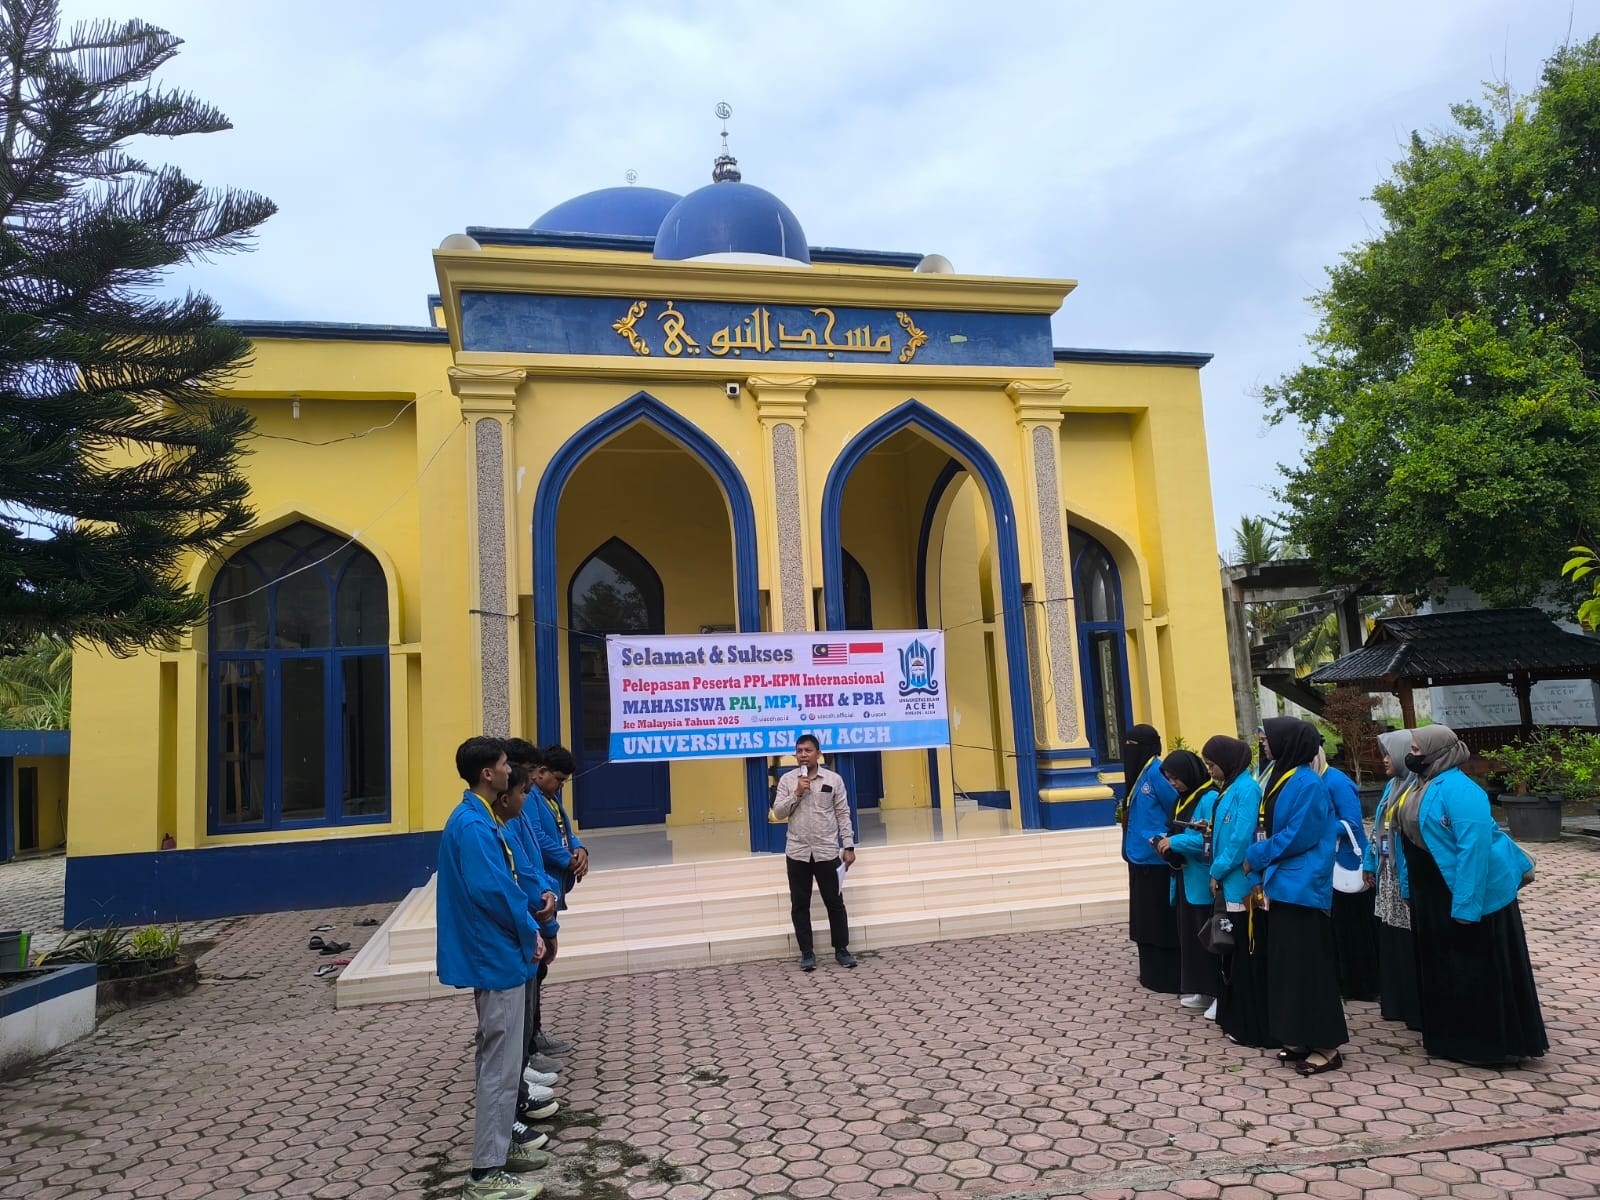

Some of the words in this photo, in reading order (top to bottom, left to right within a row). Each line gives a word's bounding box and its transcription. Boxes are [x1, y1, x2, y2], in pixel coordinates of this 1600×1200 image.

[656, 301, 776, 357] النبوي
[778, 307, 892, 359] مسجد
[622, 646, 706, 667] Selamat
[709, 645, 724, 665] &
[728, 645, 794, 664] Sukses
[622, 678, 691, 696] Pelepasan
[692, 676, 742, 691] Peserta
[744, 673, 801, 689] PPL-KPM
[803, 672, 885, 687] Internasional
[623, 697, 726, 715] MAHASISWA
[729, 696, 762, 713] PAI,
[764, 694, 803, 711] MPI,
[804, 693, 834, 708] HKI
[838, 692, 850, 706] &
[852, 691, 885, 706] PBA
[905, 702, 935, 711] ACEH
[623, 720, 636, 730] ke
[637, 718, 683, 730] Malaysia
[684, 716, 716, 727] Tahun
[717, 715, 740, 726] 2025
[622, 732, 764, 755] UNIVERSITAS
[768, 728, 833, 749] ISLM
[837, 726, 892, 745] ACEH
